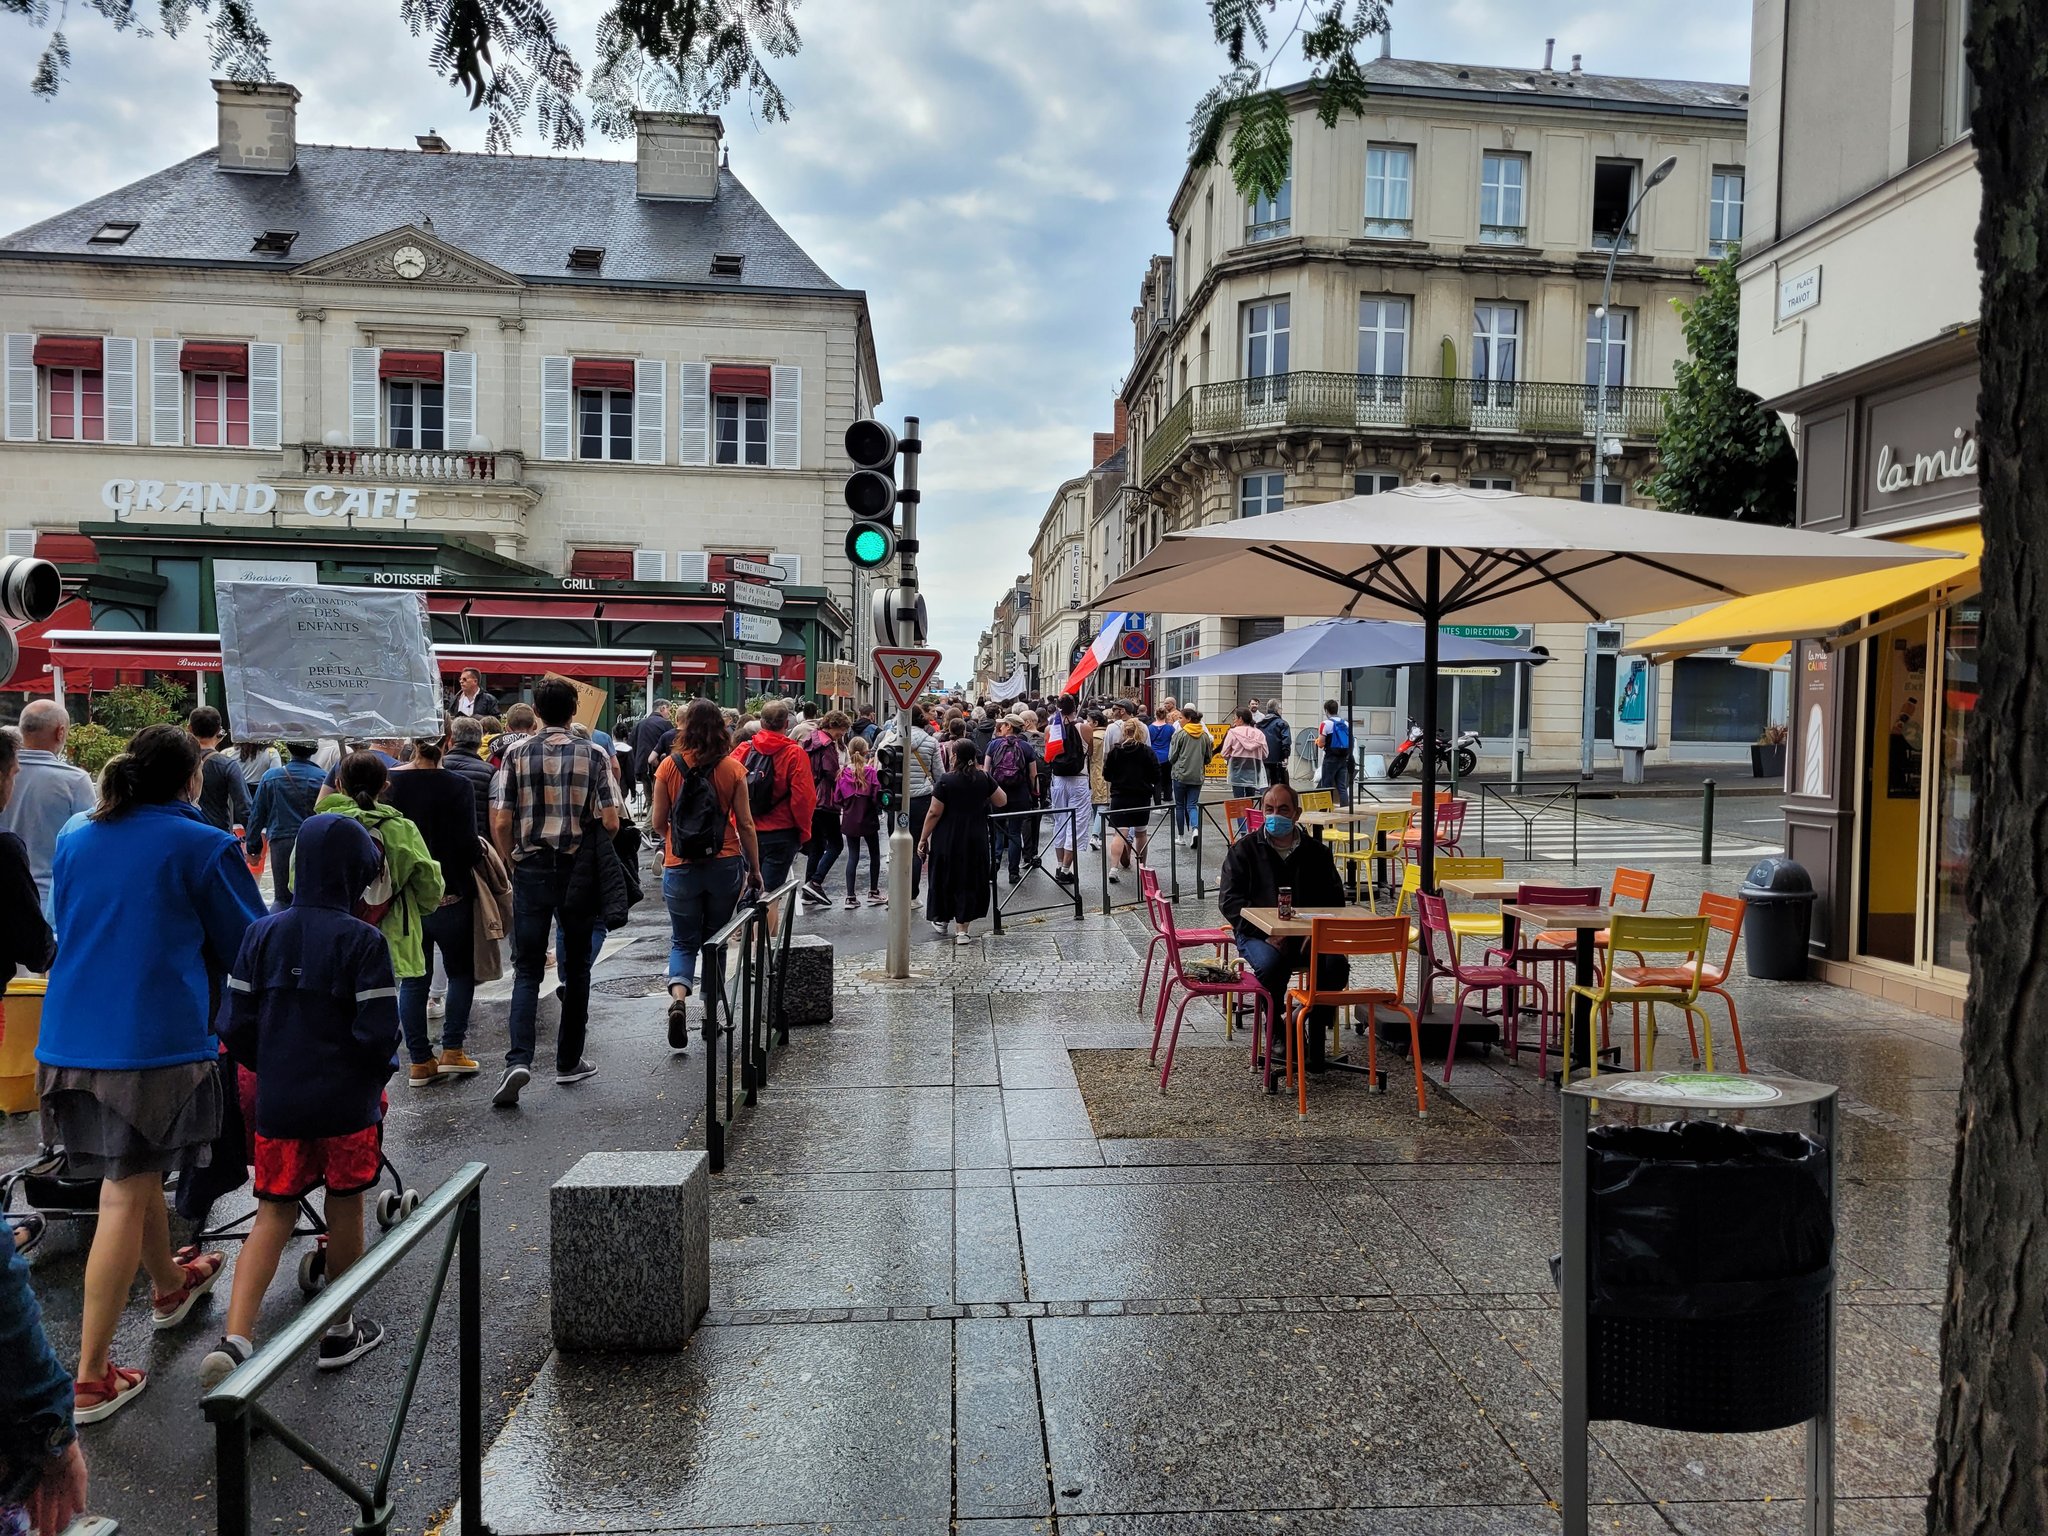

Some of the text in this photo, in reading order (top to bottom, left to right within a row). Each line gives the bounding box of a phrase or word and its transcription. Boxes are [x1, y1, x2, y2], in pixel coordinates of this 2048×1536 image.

[1796, 276, 1814, 290] PLACE
[1788, 291, 1810, 308] TRAVOT
[1877, 426, 1978, 492] la mie
[101, 478, 421, 520] GRAND CAFE
[735, 561, 766, 574] CENTRE VILLE
[240, 571, 293, 582] Brasserie
[373, 572, 443, 586] ROTISSERIE
[561, 578, 596, 590] GRILL
[711, 583, 726, 594] BR
[290, 596, 358, 607] VACCINATION
[313, 608, 341, 618] DES
[297, 621, 360, 633] ENFANTS
[1439, 627, 1510, 636] UTES DIRECTIONS
[177, 657, 221, 668] Brasserie
[354, 666, 365, 676] A
[307, 679, 369, 690] ASSUMER?
